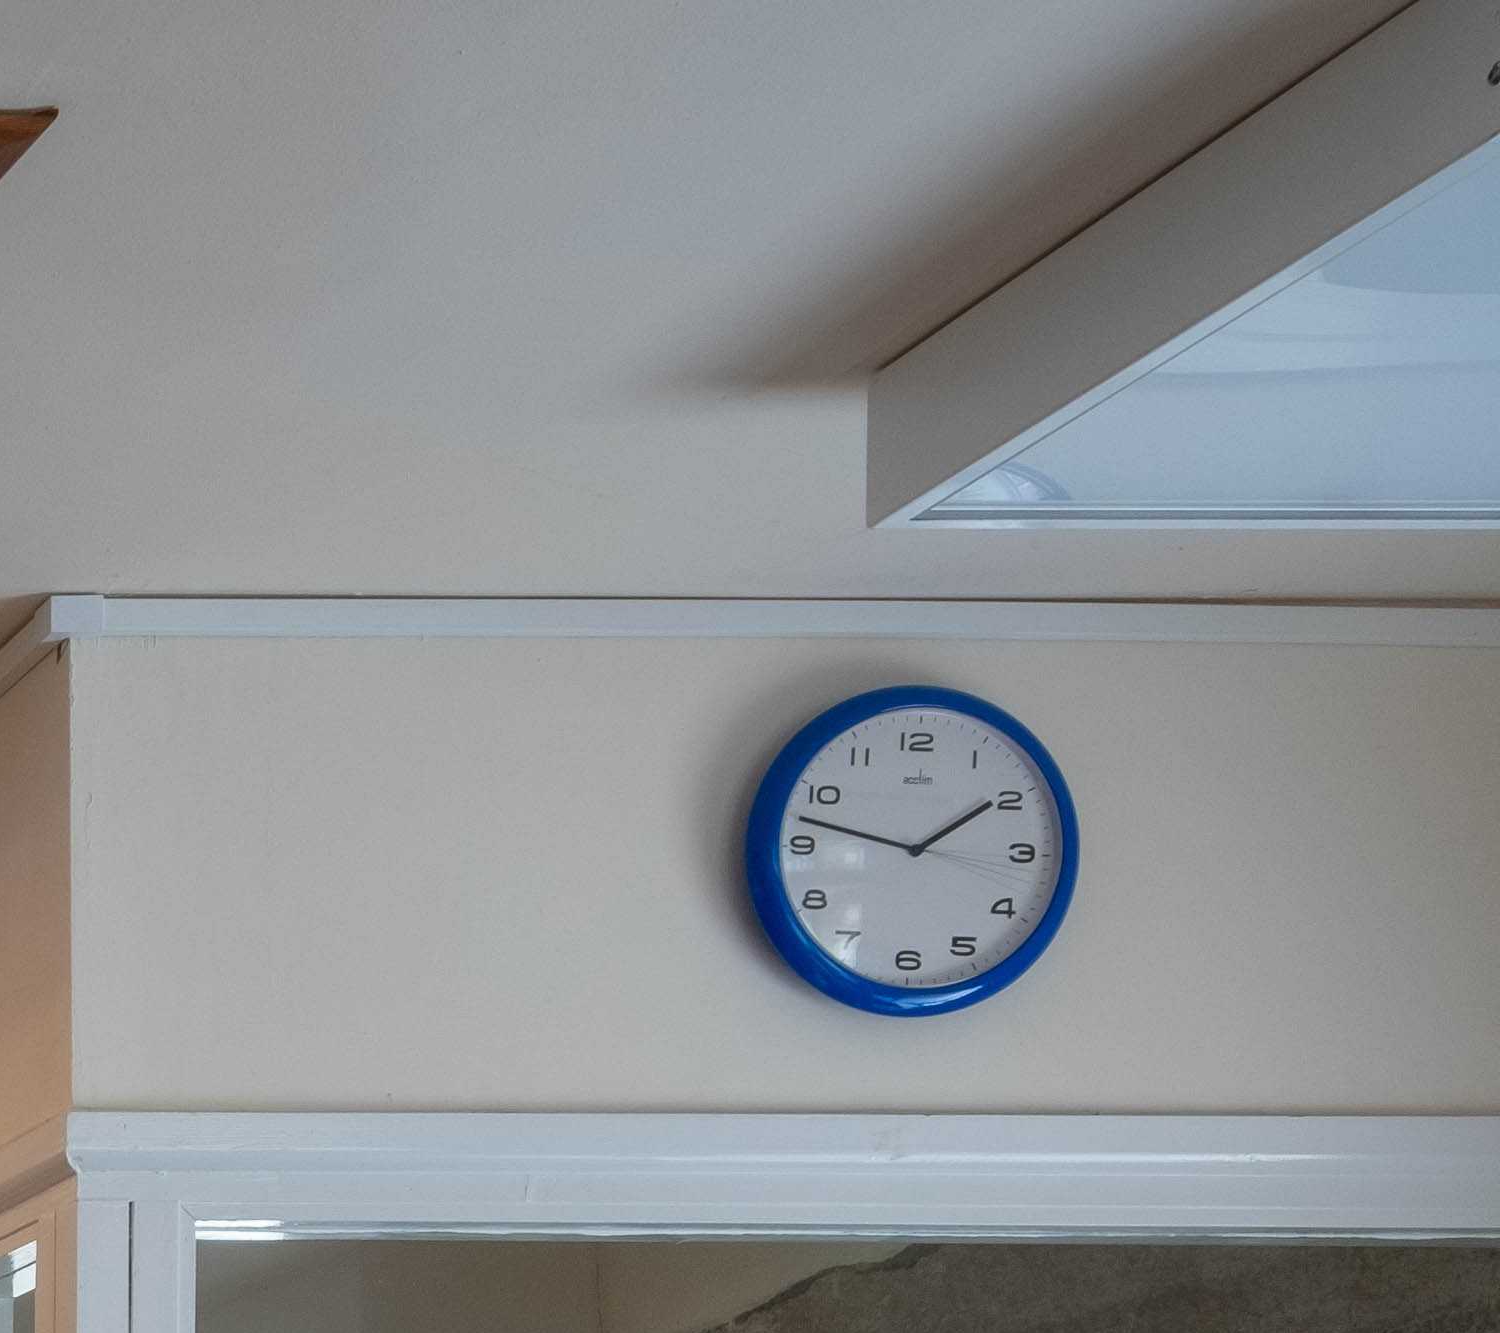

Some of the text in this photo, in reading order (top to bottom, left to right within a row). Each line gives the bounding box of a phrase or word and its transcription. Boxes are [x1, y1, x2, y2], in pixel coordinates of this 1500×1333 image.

[901, 731, 936, 753] 12
[850, 746, 871, 768] 11
[971, 749, 978, 770] 1
[808, 784, 841, 805] 10
[997, 790, 1024, 811] 2
[789, 834, 816, 856] 9
[1008, 842, 1036, 864] 3
[801, 888, 829, 911] 8
[989, 896, 1017, 919] 4
[834, 929, 862, 950] 7
[948, 935, 978, 957] 5
[894, 949, 922, 972] 6
